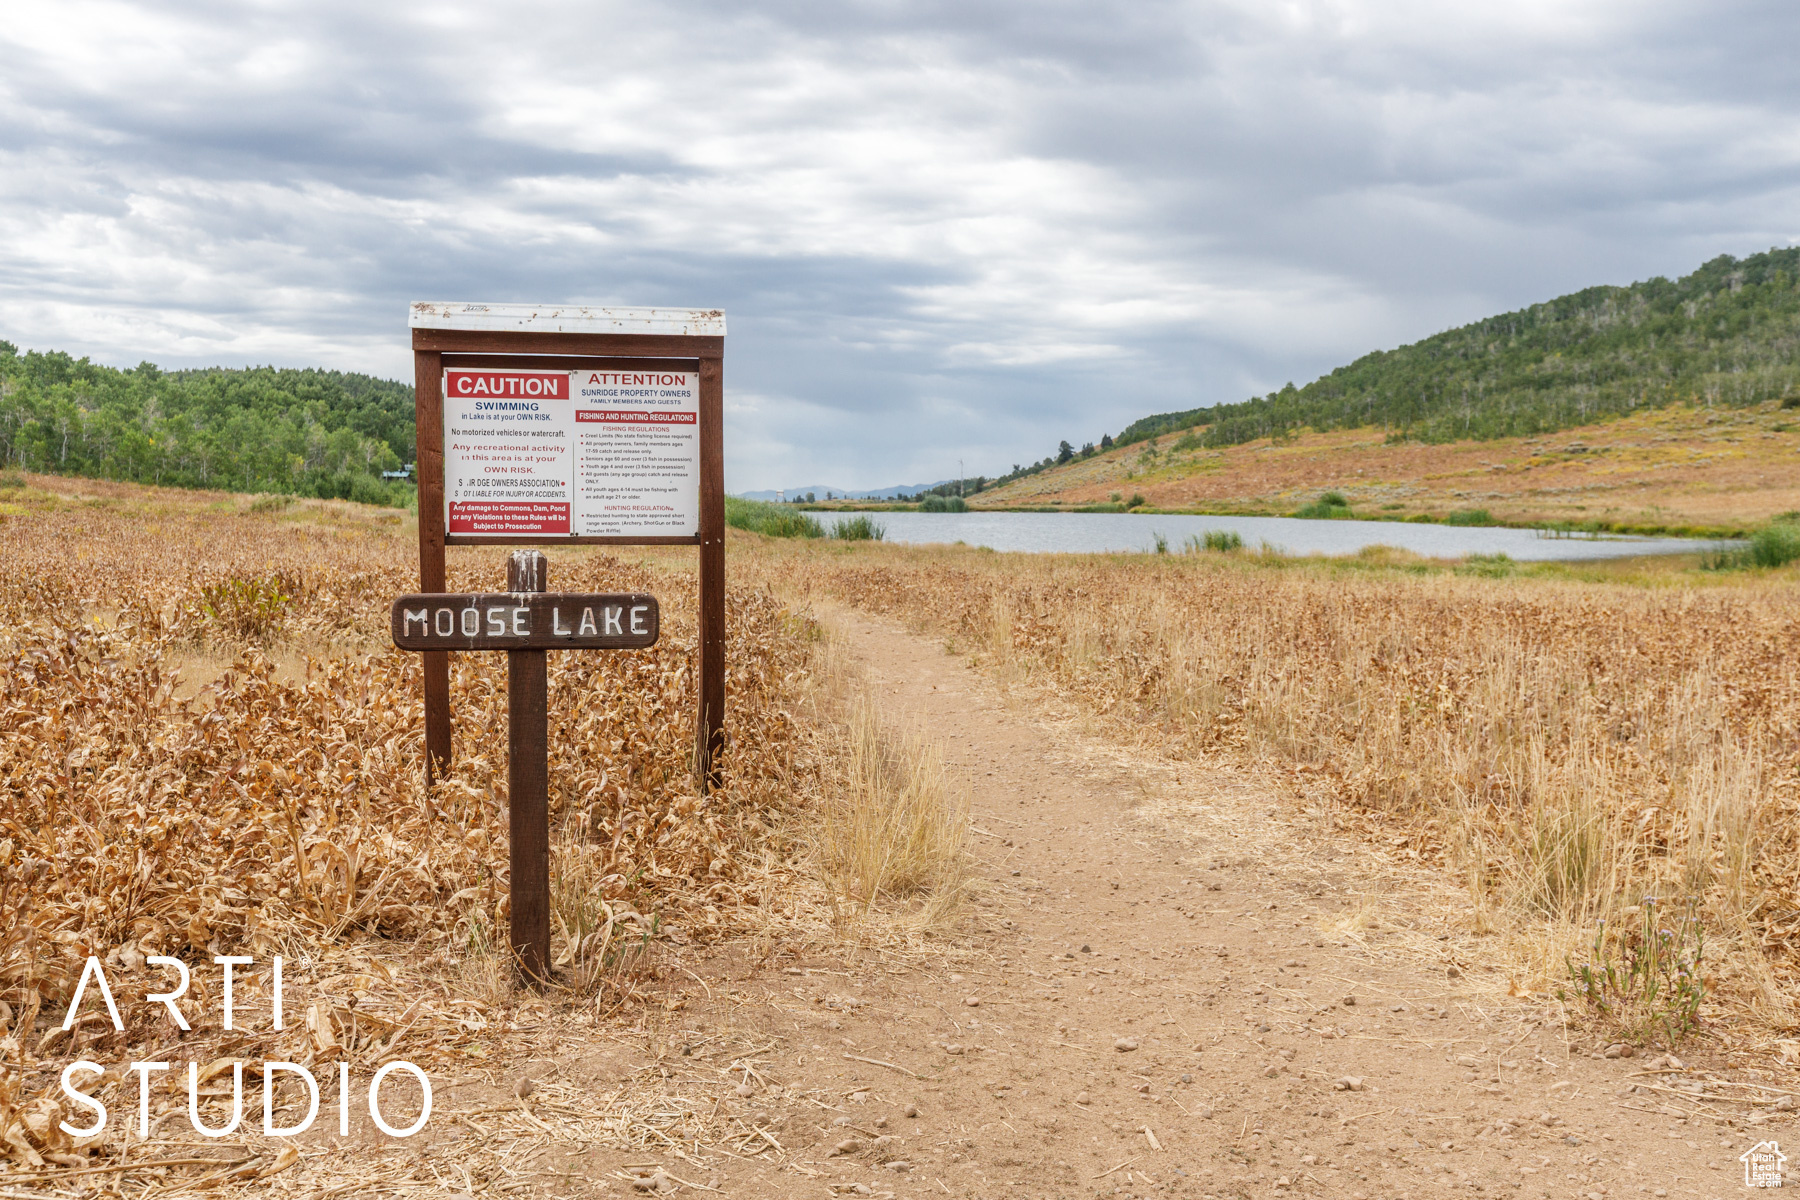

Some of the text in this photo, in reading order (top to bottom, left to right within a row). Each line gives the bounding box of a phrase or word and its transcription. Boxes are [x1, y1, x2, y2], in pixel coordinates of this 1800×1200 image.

[588, 373, 685, 386] ATTENTION
[457, 376, 558, 395] CAUTION
[475, 402, 539, 411] SWIMMING
[532, 445, 565, 453] activity
[492, 479, 518, 487] OWNERS
[519, 479, 560, 487] ASSOCIATION
[403, 606, 648, 637] MOOSE LAKE
